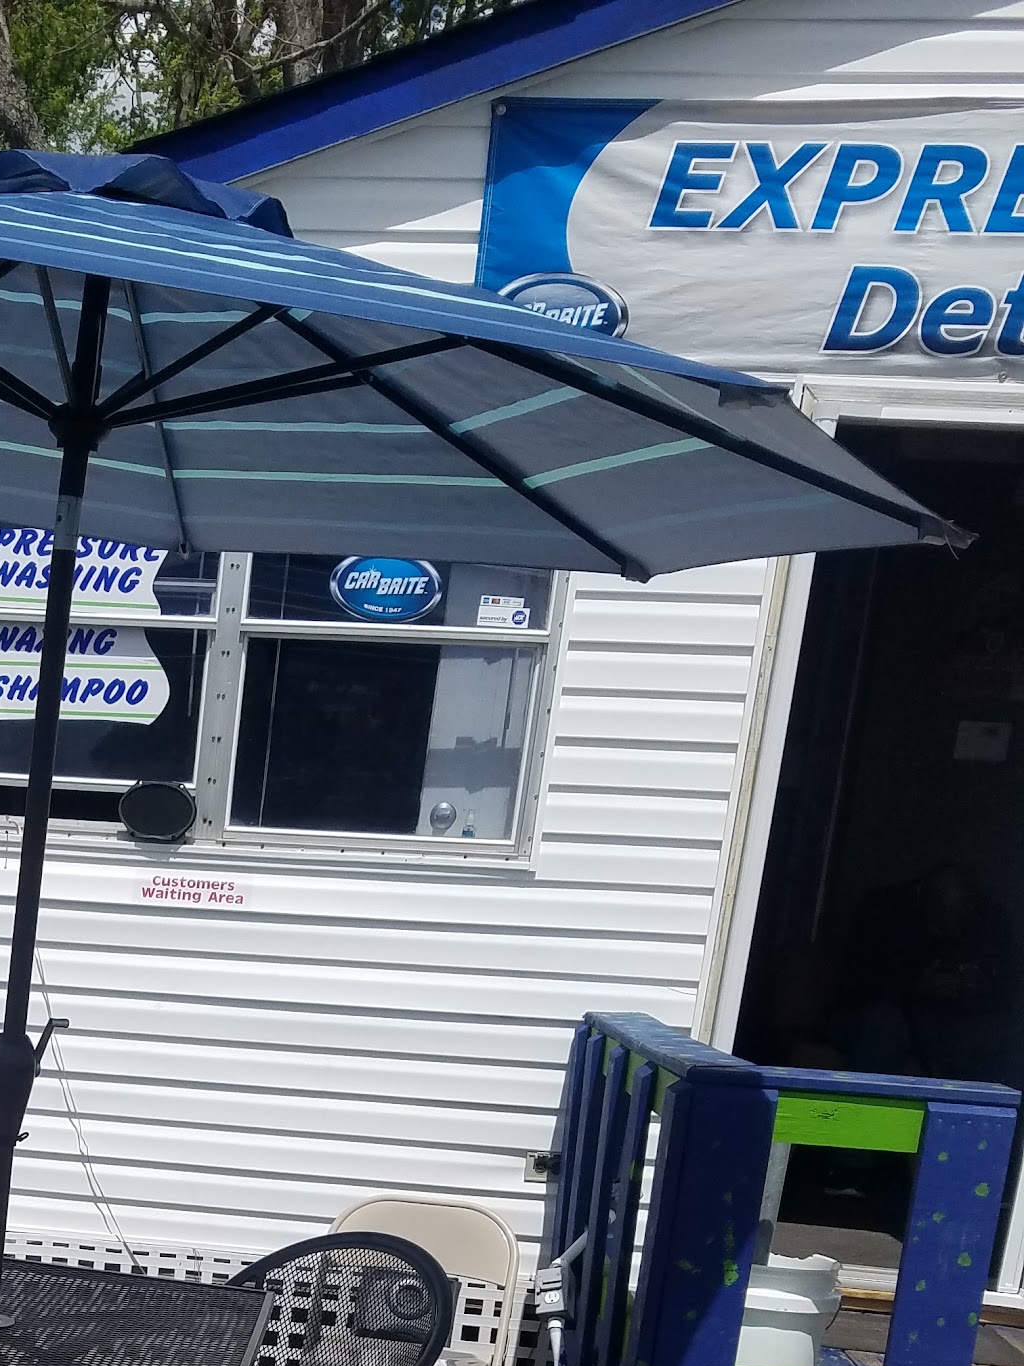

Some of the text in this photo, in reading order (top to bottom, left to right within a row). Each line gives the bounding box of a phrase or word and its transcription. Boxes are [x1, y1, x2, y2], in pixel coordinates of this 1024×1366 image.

[344, 571, 429, 595] CAR BRITE
[363, 603, 383, 613] SINCE
[152, 875, 235, 891] Customers
[141, 887, 244, 904] Waiting Area
